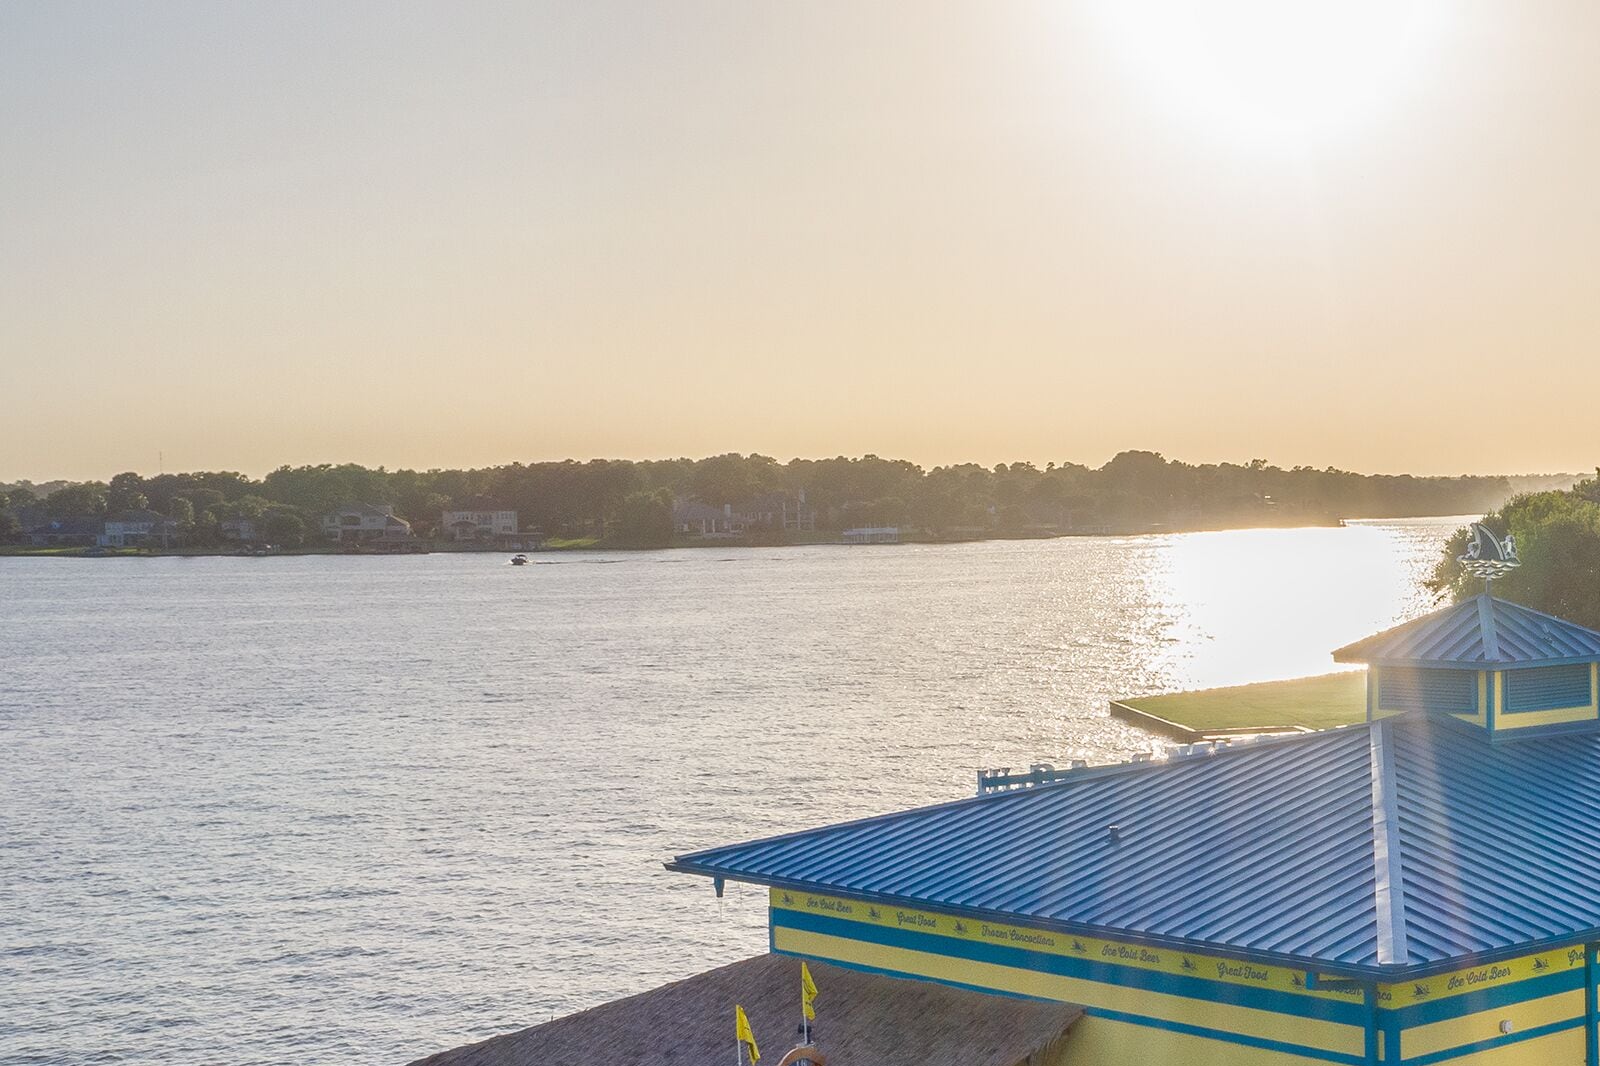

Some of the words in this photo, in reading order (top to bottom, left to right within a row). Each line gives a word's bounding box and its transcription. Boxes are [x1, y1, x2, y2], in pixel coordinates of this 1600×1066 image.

[981, 924, 1008, 939] Frozen
[1008, 928, 1055, 946] Concoctions
[1101, 943, 1118, 957] Ice
[1117, 945, 1138, 960] Cold
[1139, 949, 1160, 964] Beer
[1217, 961, 1243, 978] Great
[1242, 965, 1268, 981] Food
[1447, 975, 1465, 990] Ice
[1465, 970, 1488, 985] Cold
[1488, 965, 1512, 980] Beer
